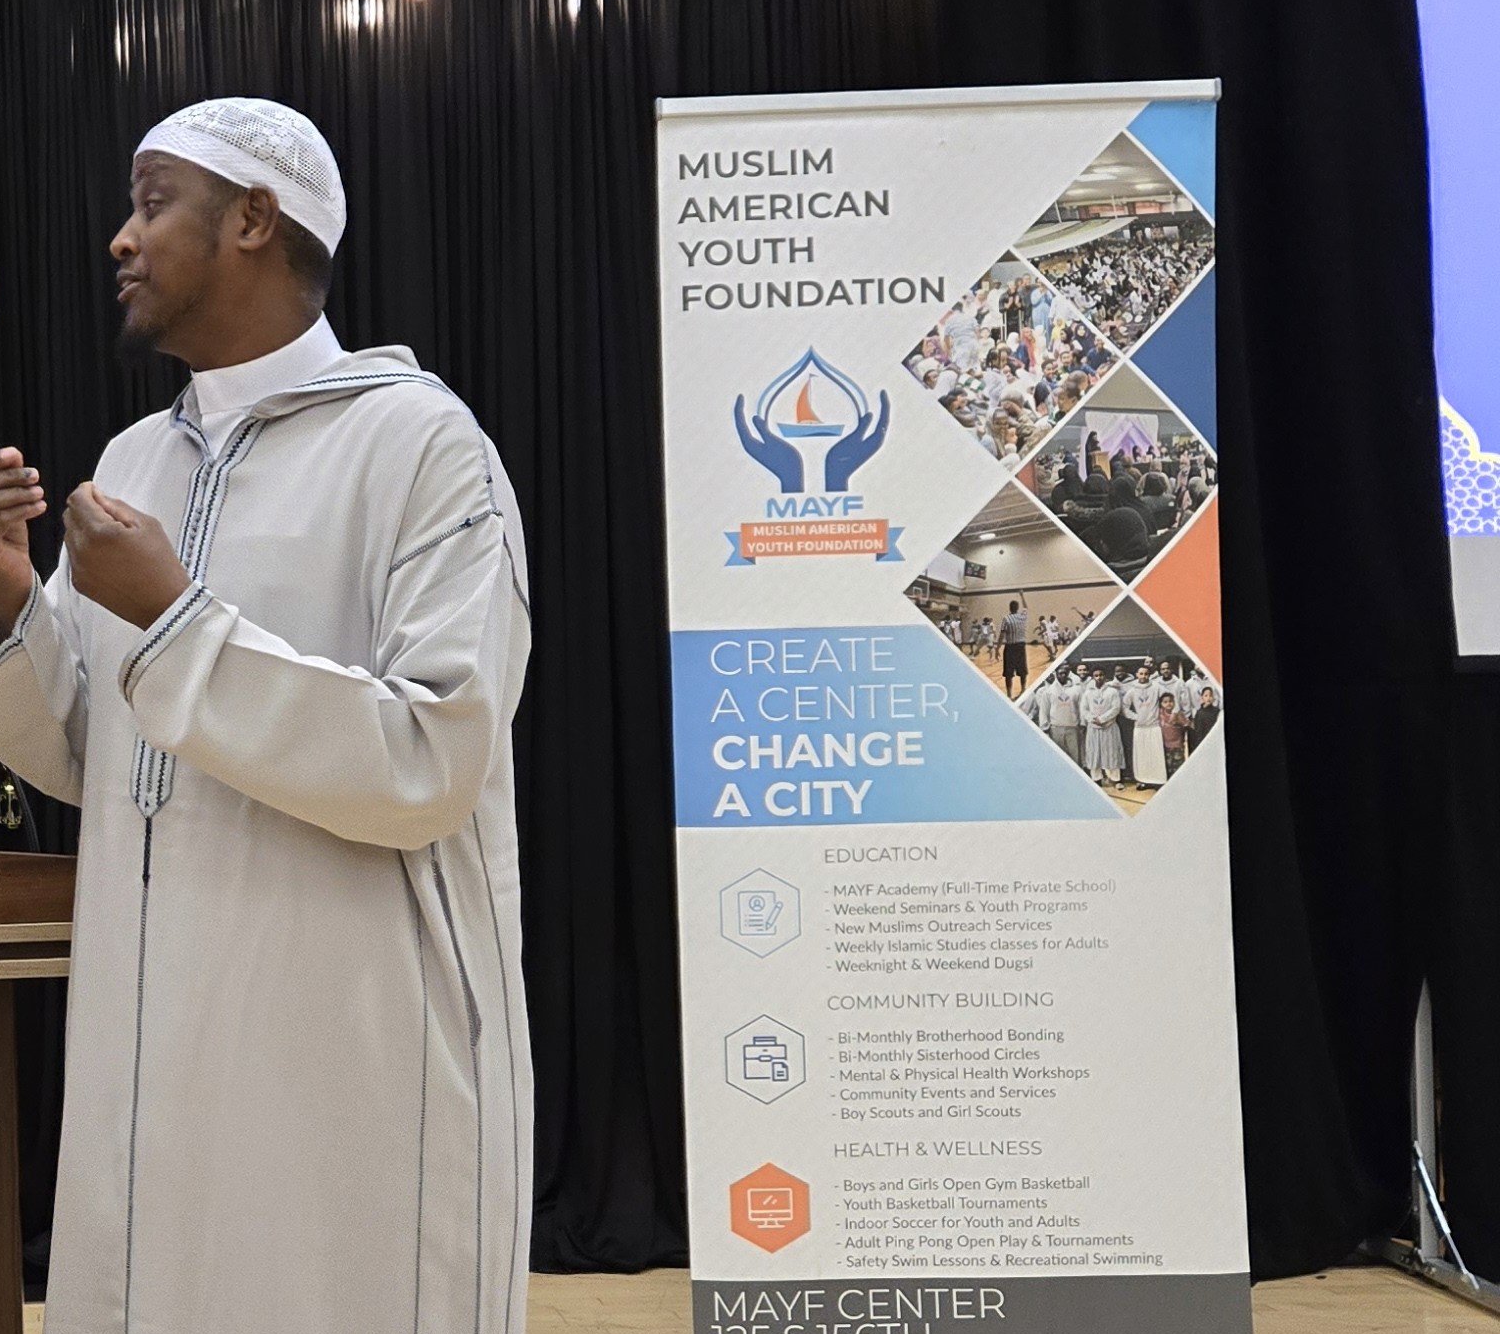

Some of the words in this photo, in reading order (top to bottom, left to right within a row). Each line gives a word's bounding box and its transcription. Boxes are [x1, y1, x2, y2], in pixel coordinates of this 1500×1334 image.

[678, 147, 834, 180] MUSLIM
[678, 189, 890, 224] AMERICAN
[678, 237, 814, 267] YOUTH
[682, 276, 946, 312] FOUNDATION
[766, 496, 864, 518] MAYF
[754, 525, 806, 537] MUSLIM
[808, 523, 877, 535] AMERICAN
[747, 541, 794, 553] YOUTH
[796, 539, 884, 551] FOUNDATION
[710, 637, 896, 675] CREATE
[710, 688, 746, 723] A
[758, 683, 959, 722] CENTER,
[712, 731, 925, 771] CHANGE
[712, 783, 752, 818] A
[764, 779, 874, 817] CITY
[824, 845, 937, 863] EDUCATION
[833, 883, 874, 897] MAYF
[876, 882, 938, 897] Academy
[941, 881, 1009, 896] (Full-Time
[1013, 880, 1061, 893] Private
[1065, 878, 1116, 894] School)
[832, 901, 896, 915] Weekend
[900, 900, 961, 914] Seminars
[964, 900, 976, 913] &
[978, 899, 1019, 913] Youth
[1023, 899, 1088, 914] Programs
[834, 922, 865, 935] New
[868, 920, 924, 933] Muslims
[927, 918, 991, 932] Outreach
[995, 918, 1052, 931] Services
[826, 993, 950, 1011] COMMUNITY
[955, 991, 1054, 1008] BUILDING
[838, 1030, 912, 1045] Bi-Monthly
[916, 1028, 1003, 1042] Brotherhood
[1007, 1028, 1064, 1043] Bonding
[838, 1048, 913, 1064] Bi-Monthly
[916, 1047, 990, 1061] Sisterhood
[993, 1047, 1040, 1060] Circles
[839, 1086, 917, 1102] Community
[920, 1086, 966, 1099] Events
[969, 1085, 995, 1098] and
[999, 1085, 1056, 1098] Services
[834, 1141, 909, 1158] HEALTH
[915, 1141, 928, 1156] &
[932, 1140, 1042, 1156] WELLNESS
[843, 1179, 875, 1193] Boys
[878, 1177, 904, 1191] and
[907, 1177, 939, 1190] Girls
[942, 1177, 981, 1192] Open
[984, 1177, 1017, 1192] Gym
[1021, 1175, 1090, 1190] Basketball
[844, 1216, 889, 1230] Indoor
[892, 1216, 938, 1229] Soccer
[941, 1215, 961, 1228] for
[963, 1215, 1004, 1228] Youth
[1007, 1215, 1033, 1227] and
[1036, 1214, 1080, 1227] Adults
[713, 1290, 825, 1322] MAYF
[836, 1288, 1006, 1320] CENTER
